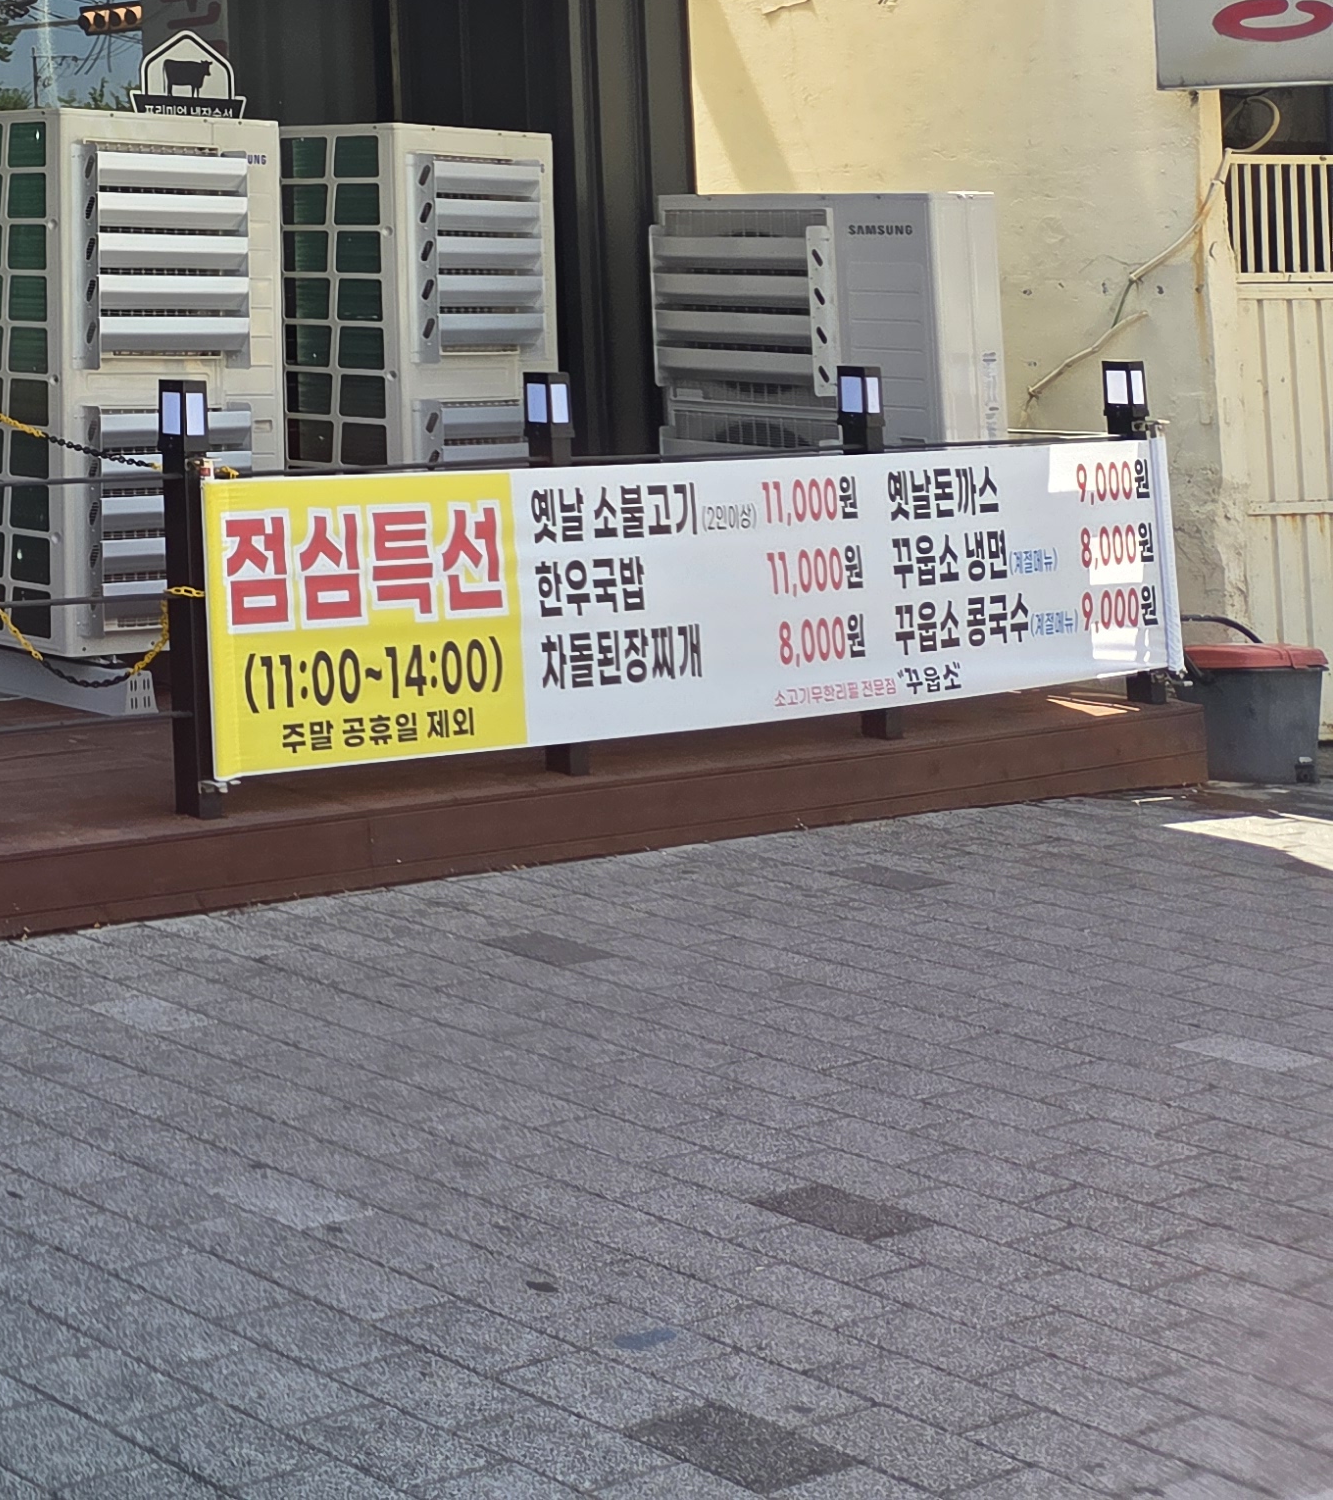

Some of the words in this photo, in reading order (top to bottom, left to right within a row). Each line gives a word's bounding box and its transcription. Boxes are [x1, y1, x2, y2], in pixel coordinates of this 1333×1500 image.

[848, 224, 913, 236] SAMSUNG
[531, 486, 585, 544] 옛날
[593, 482, 698, 539] 소불고기
[702, 502, 758, 532] (2인이상)
[762, 476, 859, 526] 11,000원
[888, 465, 1000, 521] 옛날돈까스
[1076, 459, 1151, 505] 9,000원
[225, 507, 504, 626] 점심특선
[535, 556, 645, 617] 한우국밥
[767, 545, 864, 598] 11,000원
[892, 533, 960, 589] 꾸웁소
[964, 529, 1008, 581] 냉면
[1009, 546, 1058, 576] (계절메뉴)
[1081, 522, 1155, 569] 8,000원
[541, 624, 703, 690] 차돌된장찌개
[779, 613, 866, 668] 8,000원
[895, 600, 961, 656] 꾸웁소
[966, 592, 1030, 647] 콩국수
[1030, 608, 1079, 638] (계절메뉴)
[1082, 585, 1159, 634] 9,000원
[244, 636, 503, 713] (11:00~14:00)
[774, 681, 859, 708] 소고기무한리필
[861, 677, 897, 698] 전문점
[282, 720, 333, 754] 주말
[343, 712, 418, 748] 공휴일
[426, 707, 475, 738] 제외
